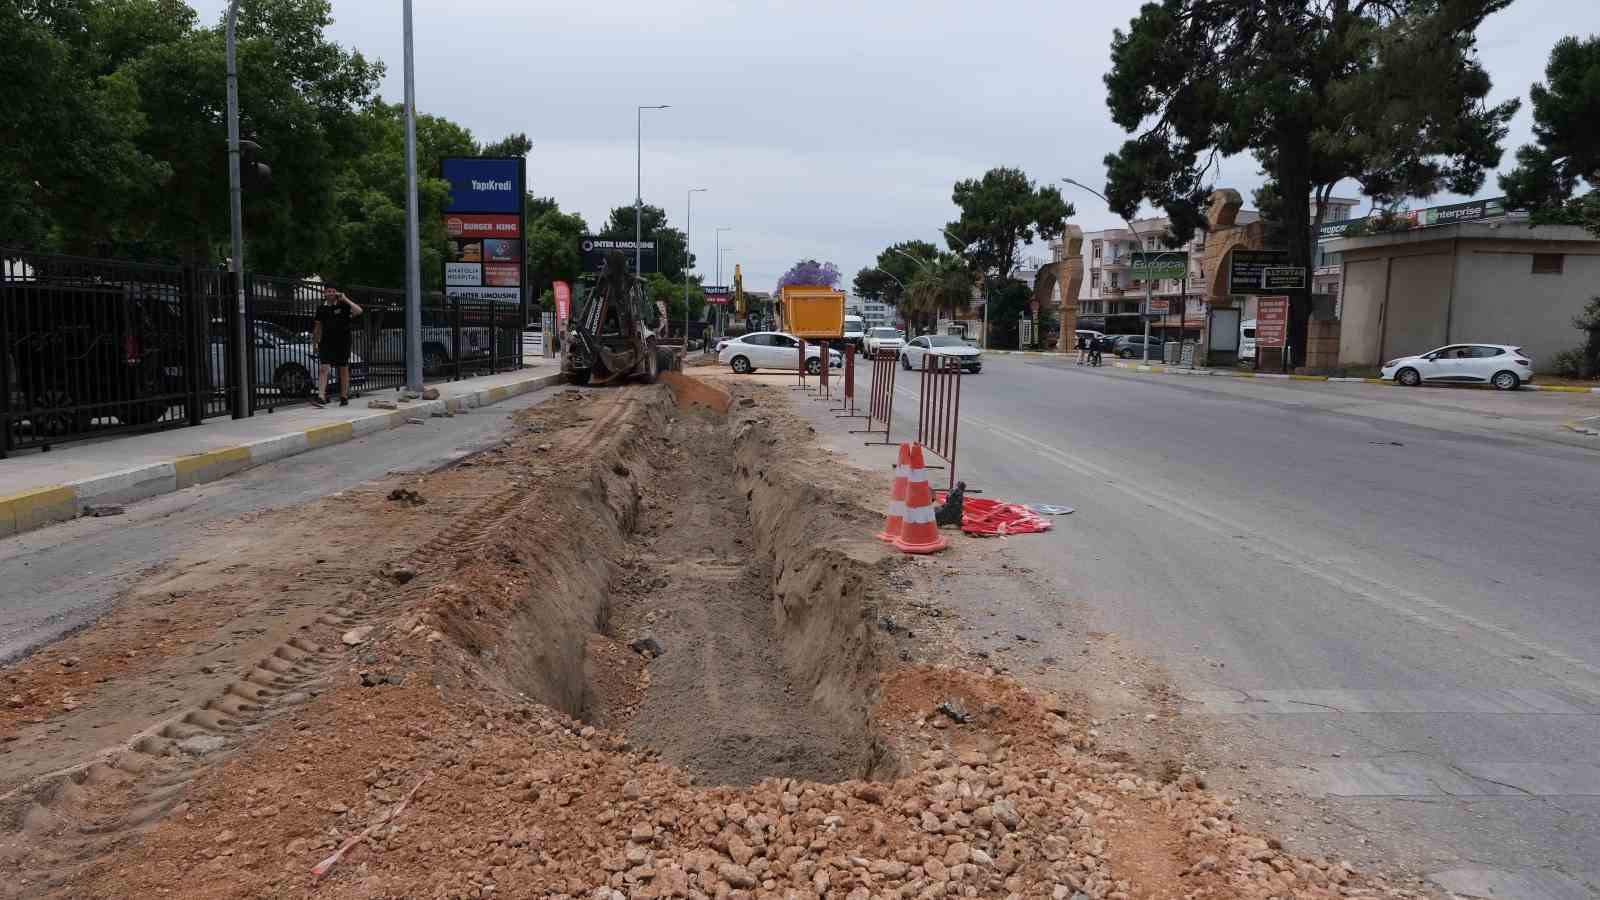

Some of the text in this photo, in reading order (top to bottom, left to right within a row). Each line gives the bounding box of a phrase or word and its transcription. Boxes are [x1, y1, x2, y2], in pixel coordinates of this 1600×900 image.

[463, 223, 493, 231] BURGER
[495, 223, 517, 231] KING
[593, 240, 614, 248] INTER
